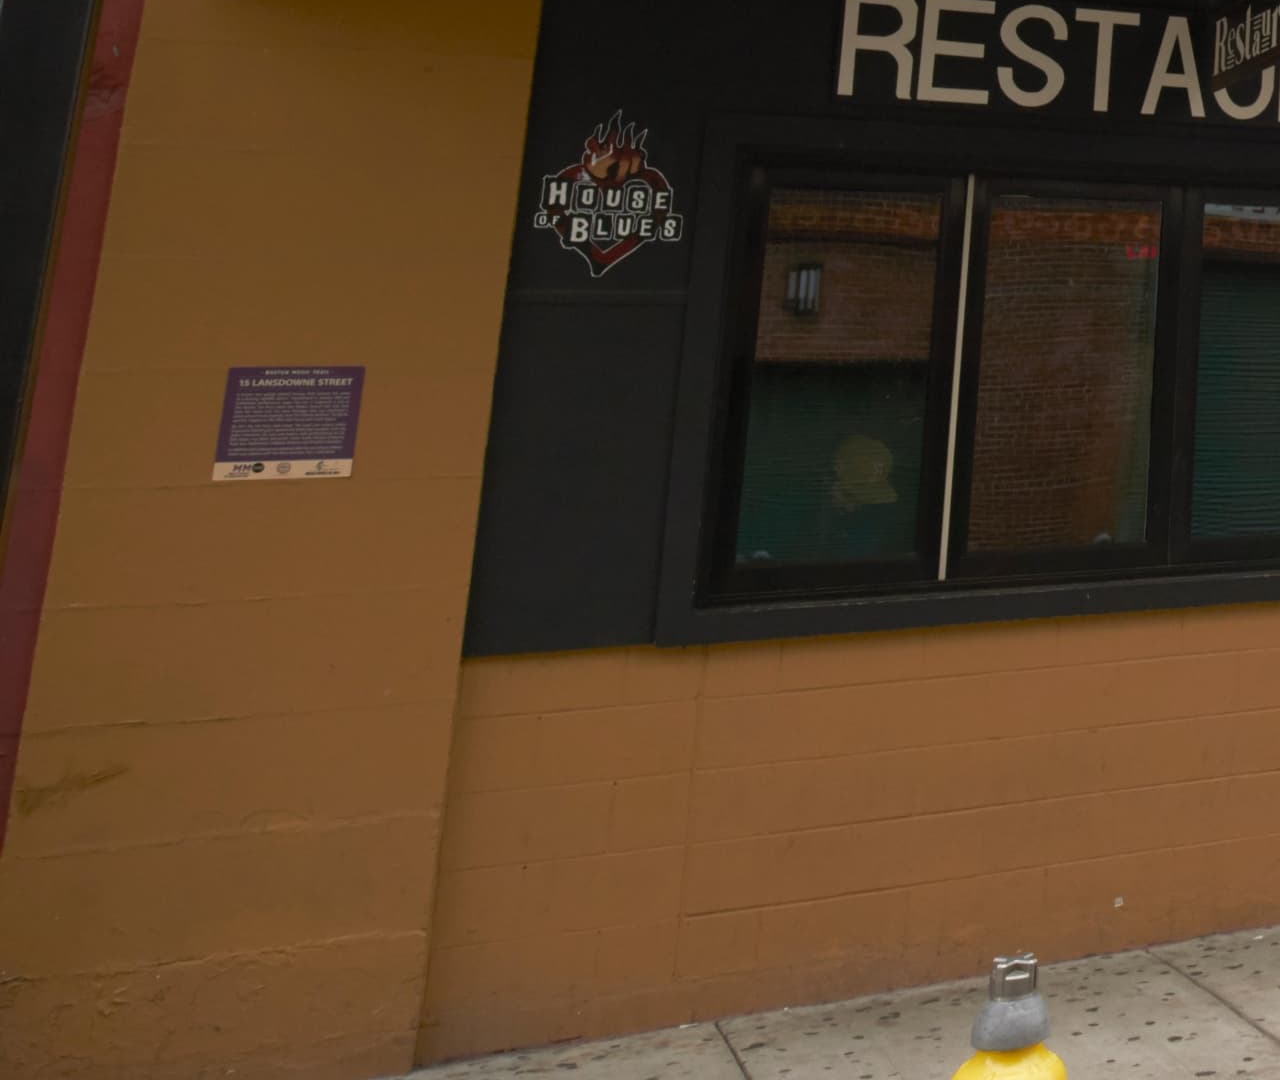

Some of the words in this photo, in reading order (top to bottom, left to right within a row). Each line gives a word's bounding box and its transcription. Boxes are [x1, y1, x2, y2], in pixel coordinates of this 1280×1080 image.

[548, 182, 669, 209] HOUSE
[539, 215, 560, 225] OF
[570, 218, 677, 243] BLUES
[251, 379, 316, 387] LANSDOWNE
[317, 378, 353, 386] STREET
